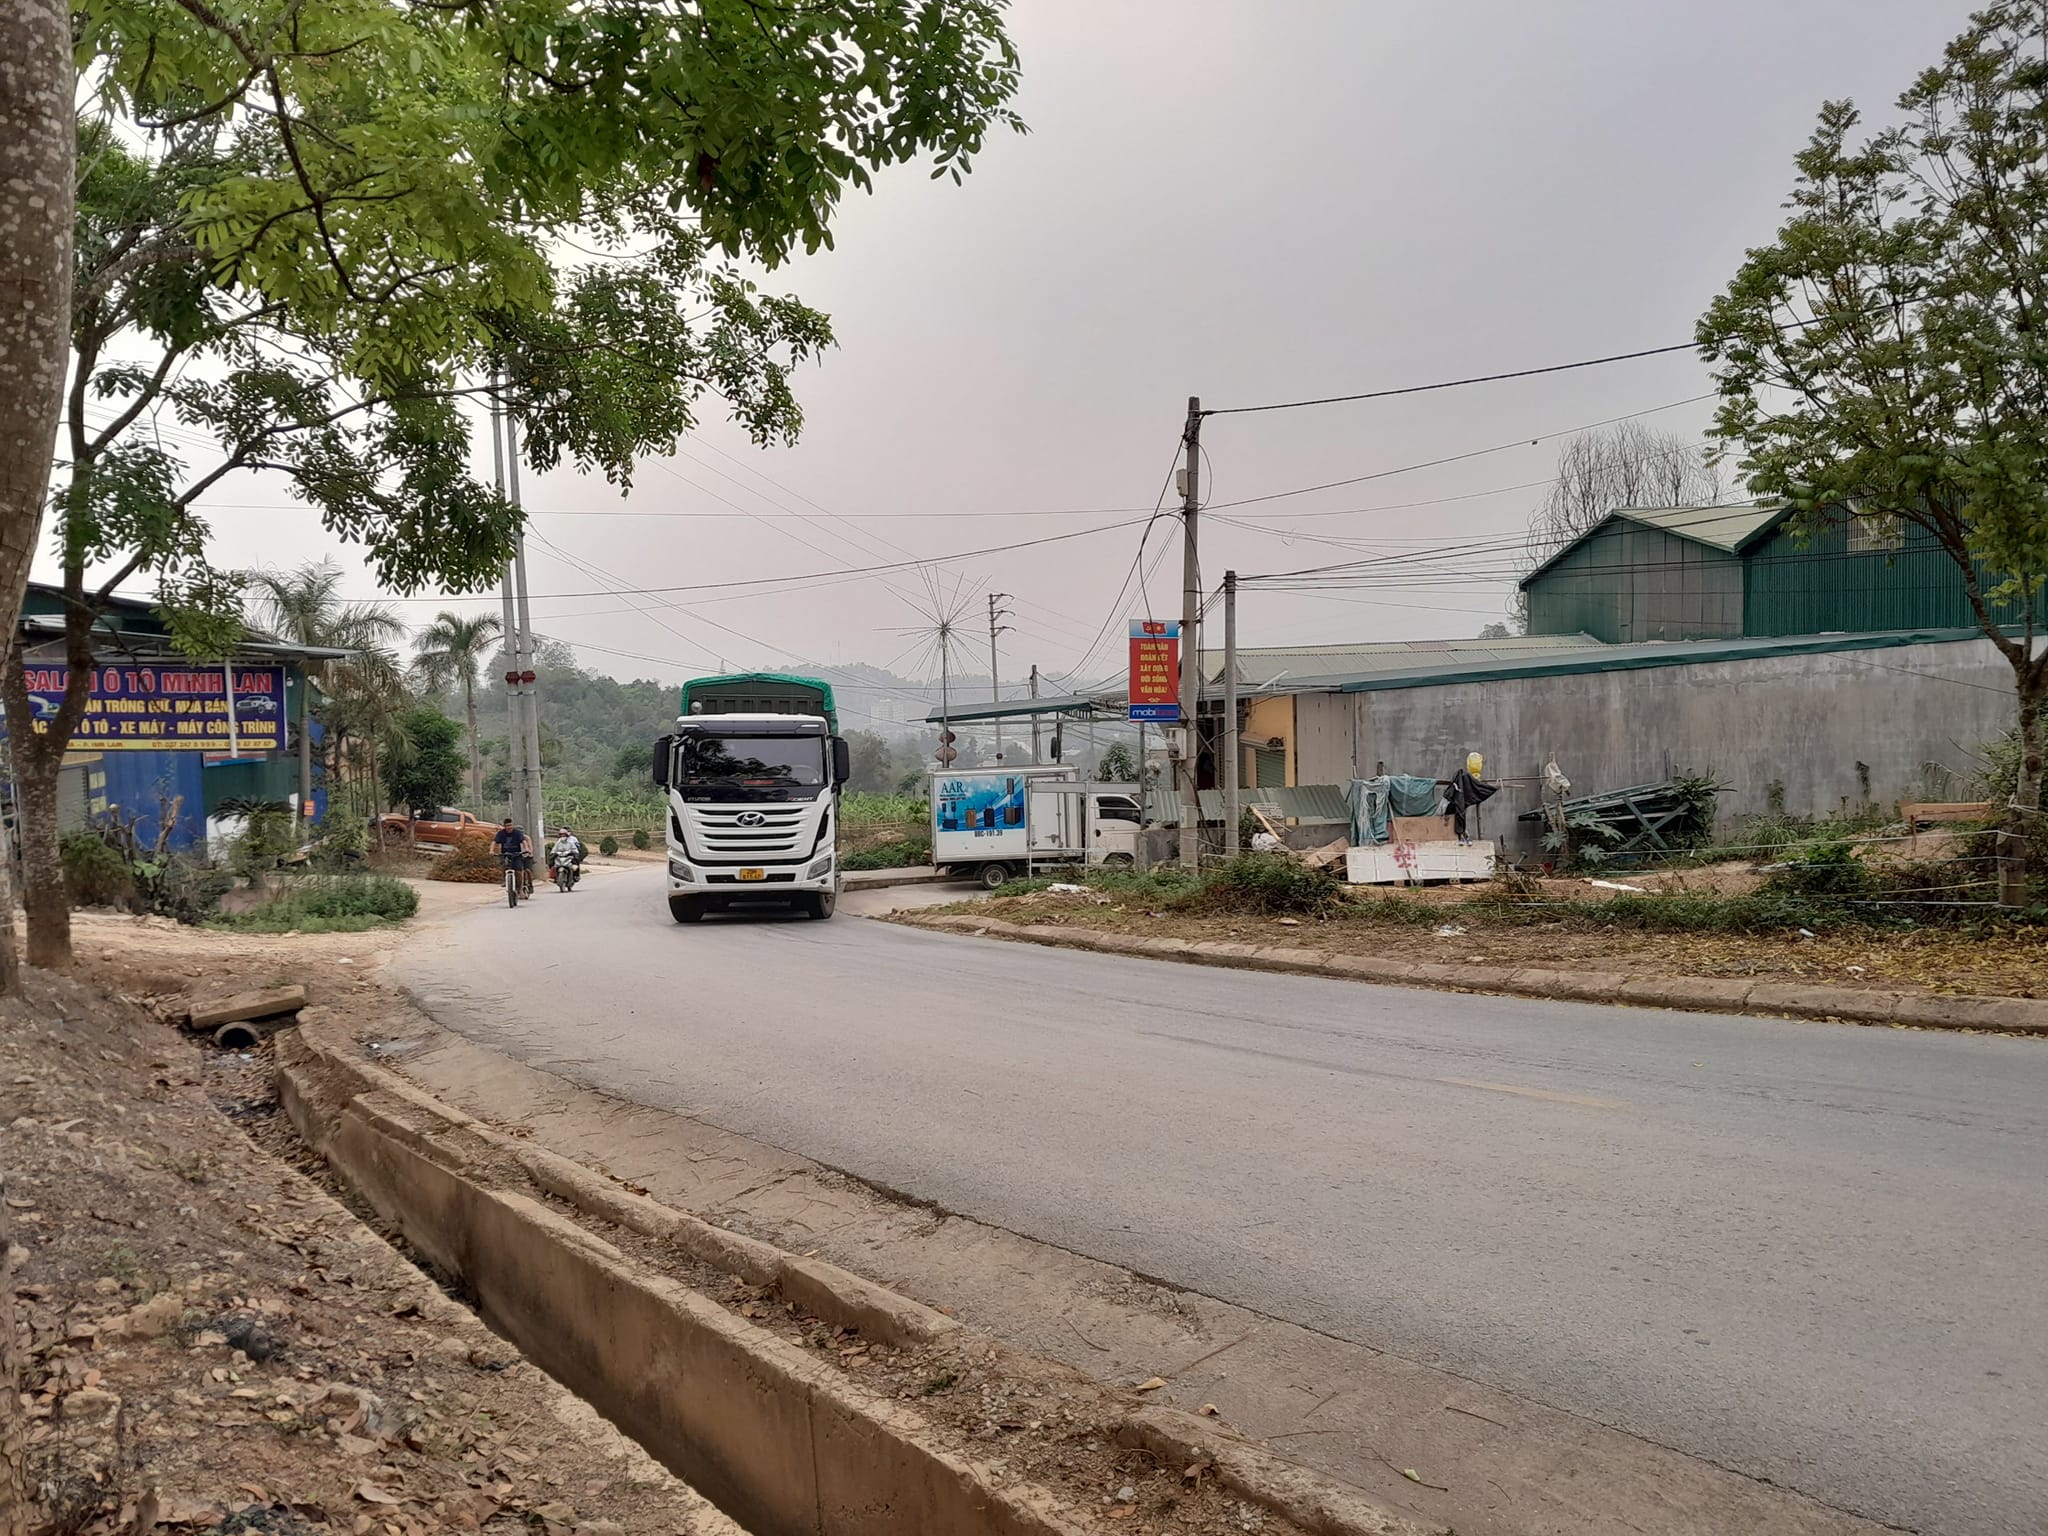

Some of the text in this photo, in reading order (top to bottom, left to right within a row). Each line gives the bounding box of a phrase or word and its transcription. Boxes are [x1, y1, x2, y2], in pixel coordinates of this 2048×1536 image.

[103, 667, 122, 693] Ô
[126, 667, 156, 694] TÔ
[161, 672, 224, 694] MINH
[232, 672, 272, 694] LAN
[80, 717, 91, 735] Ô
[93, 717, 109, 735] TÔ
[119, 720, 137, 735] XE
[139, 718, 165, 735] MÁY
[177, 718, 204, 735] MÁY
[241, 718, 276, 735] TRÌNH
[940, 781, 964, 794] AAR
